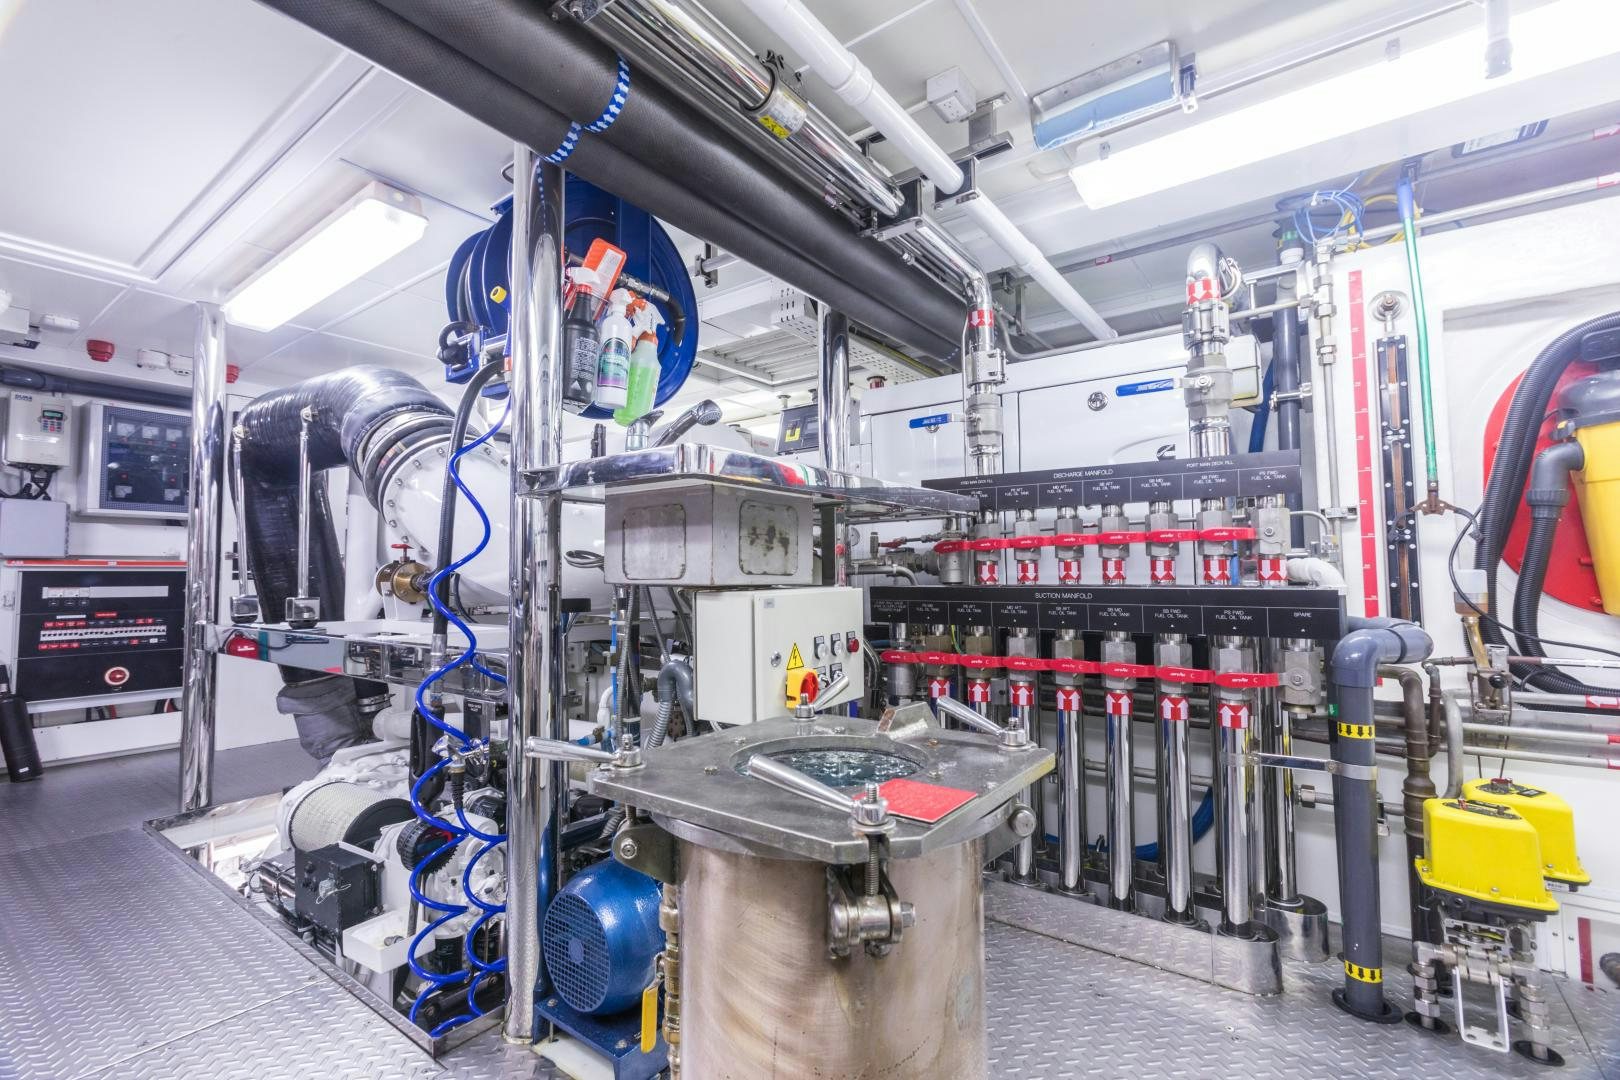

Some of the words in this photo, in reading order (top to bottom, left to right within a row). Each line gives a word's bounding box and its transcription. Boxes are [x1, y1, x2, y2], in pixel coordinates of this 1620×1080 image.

[1053, 471, 1083, 479] DISCHARGE
[1084, 468, 1114, 476] MANIFOLD
[1061, 592, 1093, 600] MANIFOLD
